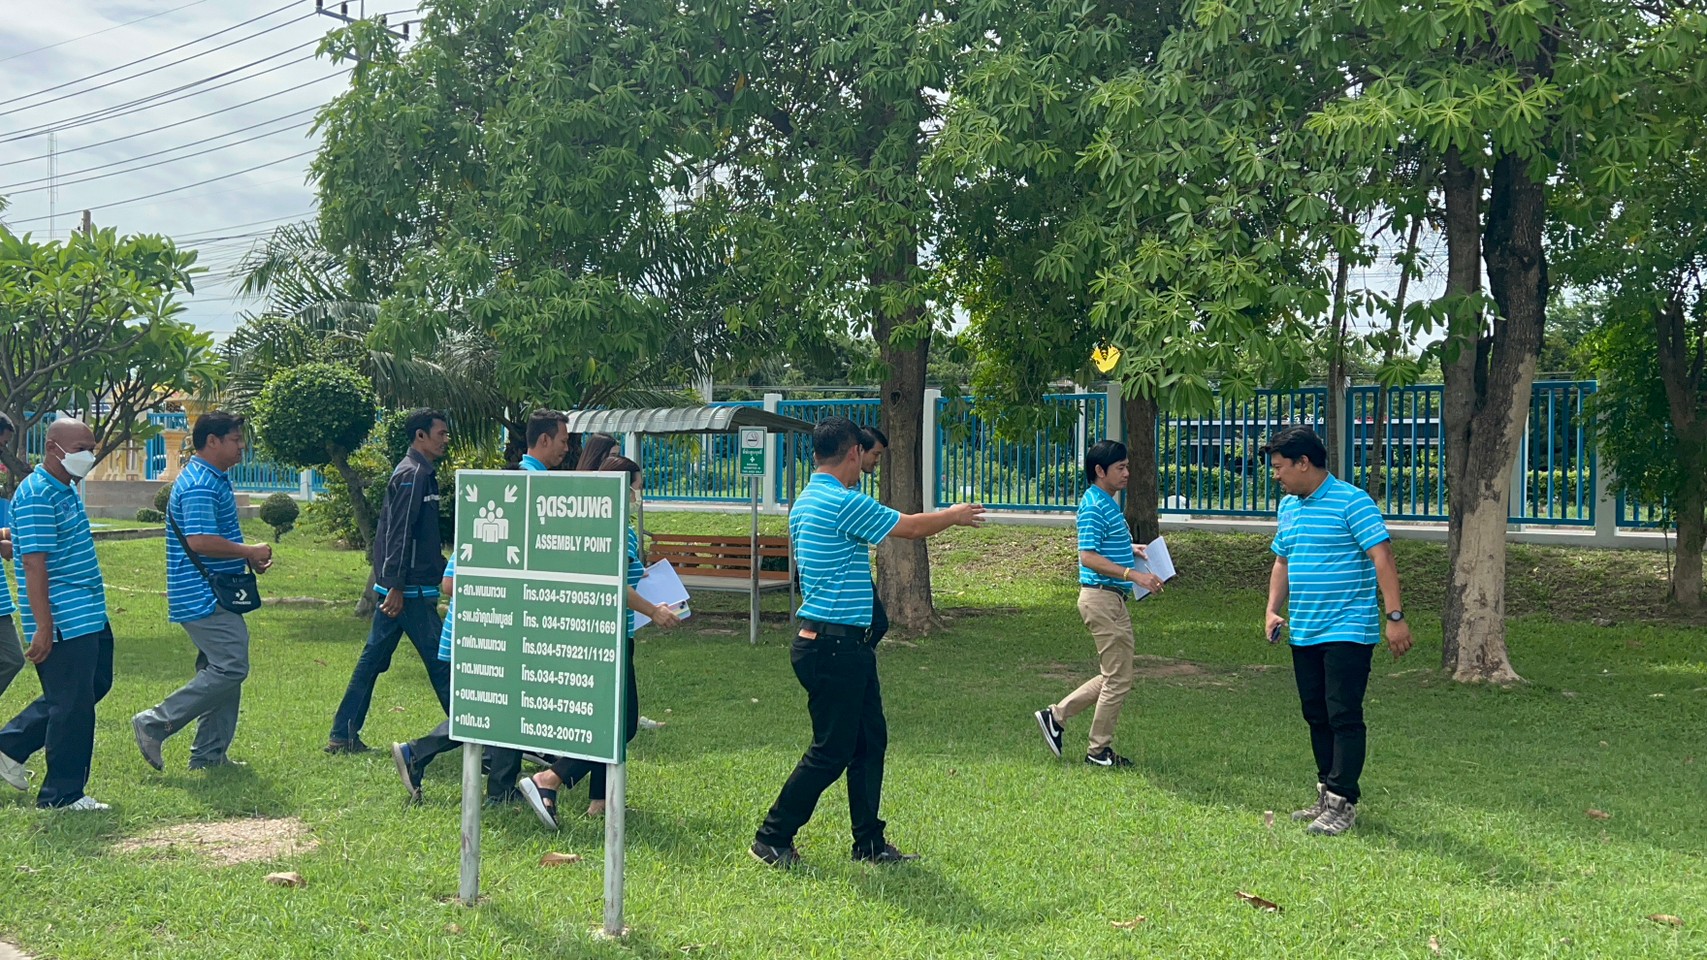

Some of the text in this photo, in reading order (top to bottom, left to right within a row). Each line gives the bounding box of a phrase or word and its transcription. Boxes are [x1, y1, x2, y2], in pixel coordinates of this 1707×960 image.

[536, 495, 612, 525] จุดรวมพล
[535, 534, 612, 553] ASSEMBLY POINT
[523, 583, 618, 607] โทร.034-579053/191
[523, 610, 616, 635] โทร. 034-579031/1669
[522, 636, 615, 662] โทร.034-579221/1129
[521, 663, 594, 688] โทร.034-579034
[521, 690, 594, 716] โทร.034-579456
[520, 716, 593, 744] โทร.032-200779
